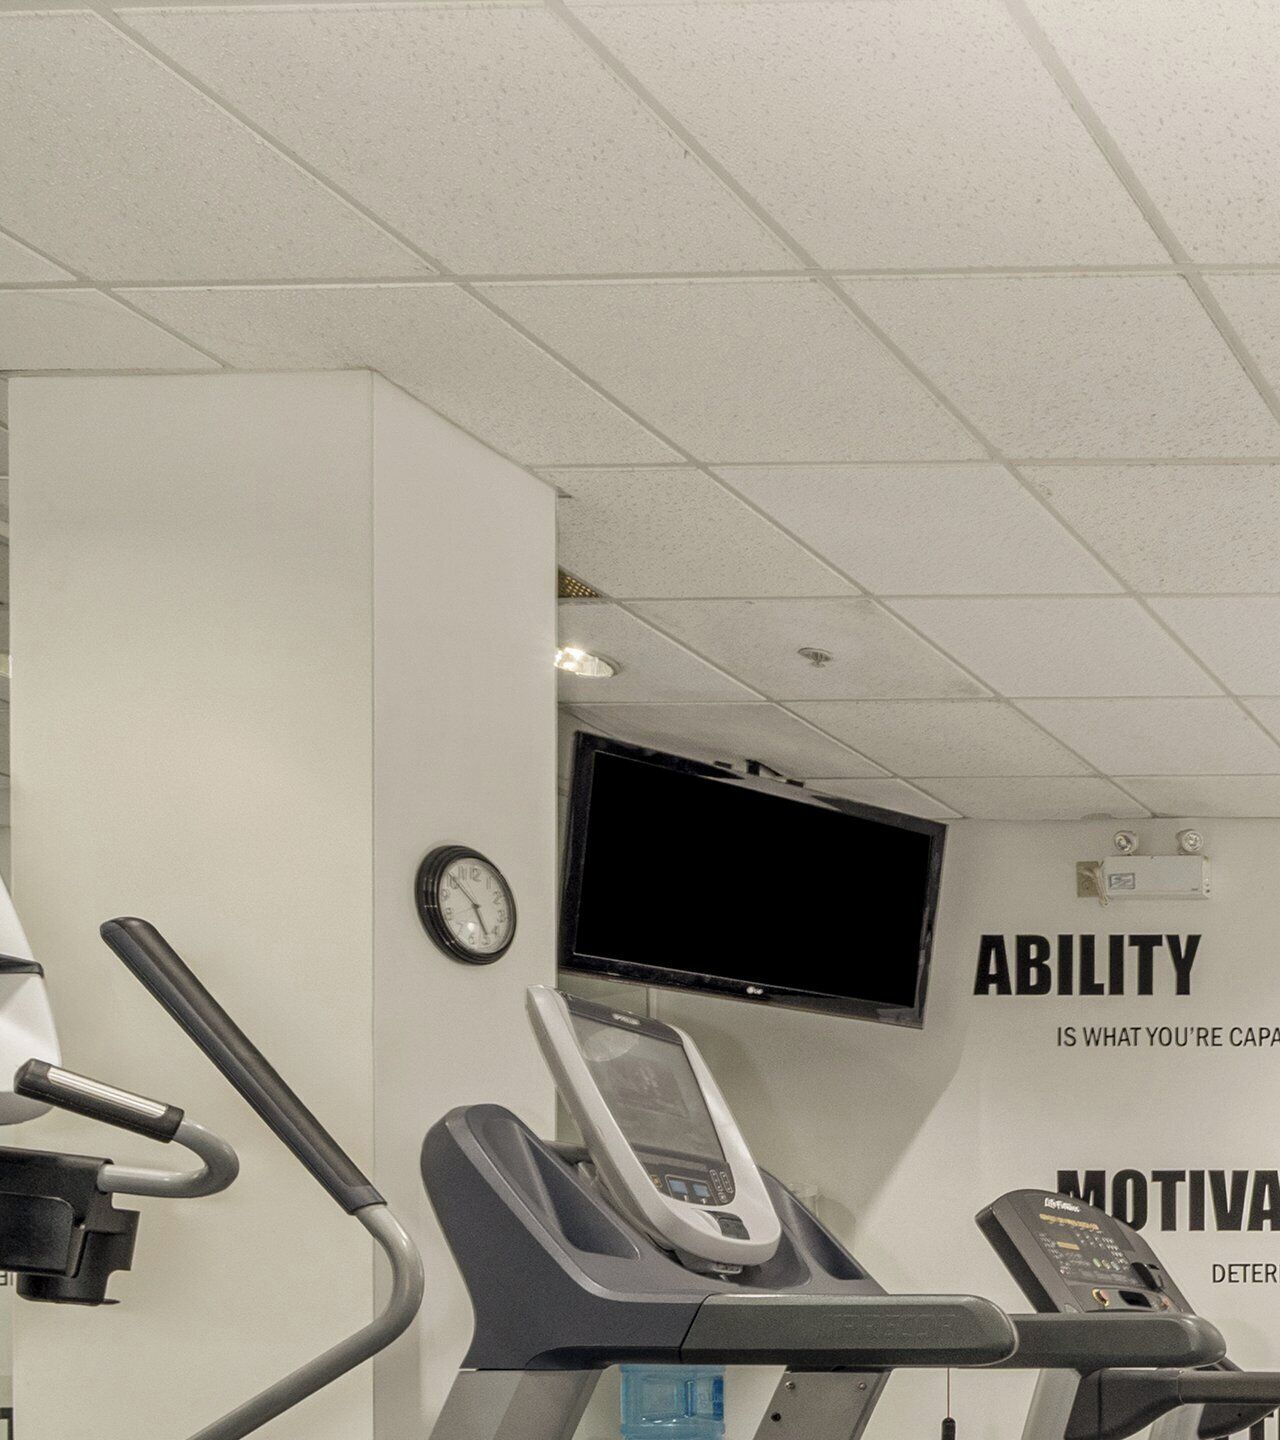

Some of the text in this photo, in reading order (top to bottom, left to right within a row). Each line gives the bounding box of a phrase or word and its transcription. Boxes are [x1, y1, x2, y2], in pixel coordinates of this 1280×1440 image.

[972, 933, 1202, 996] ABILITY
[1057, 1026, 1077, 1047] IS
[1082, 1026, 1142, 1047] WHAT
[1145, 1026, 1223, 1047] YOU'RE
